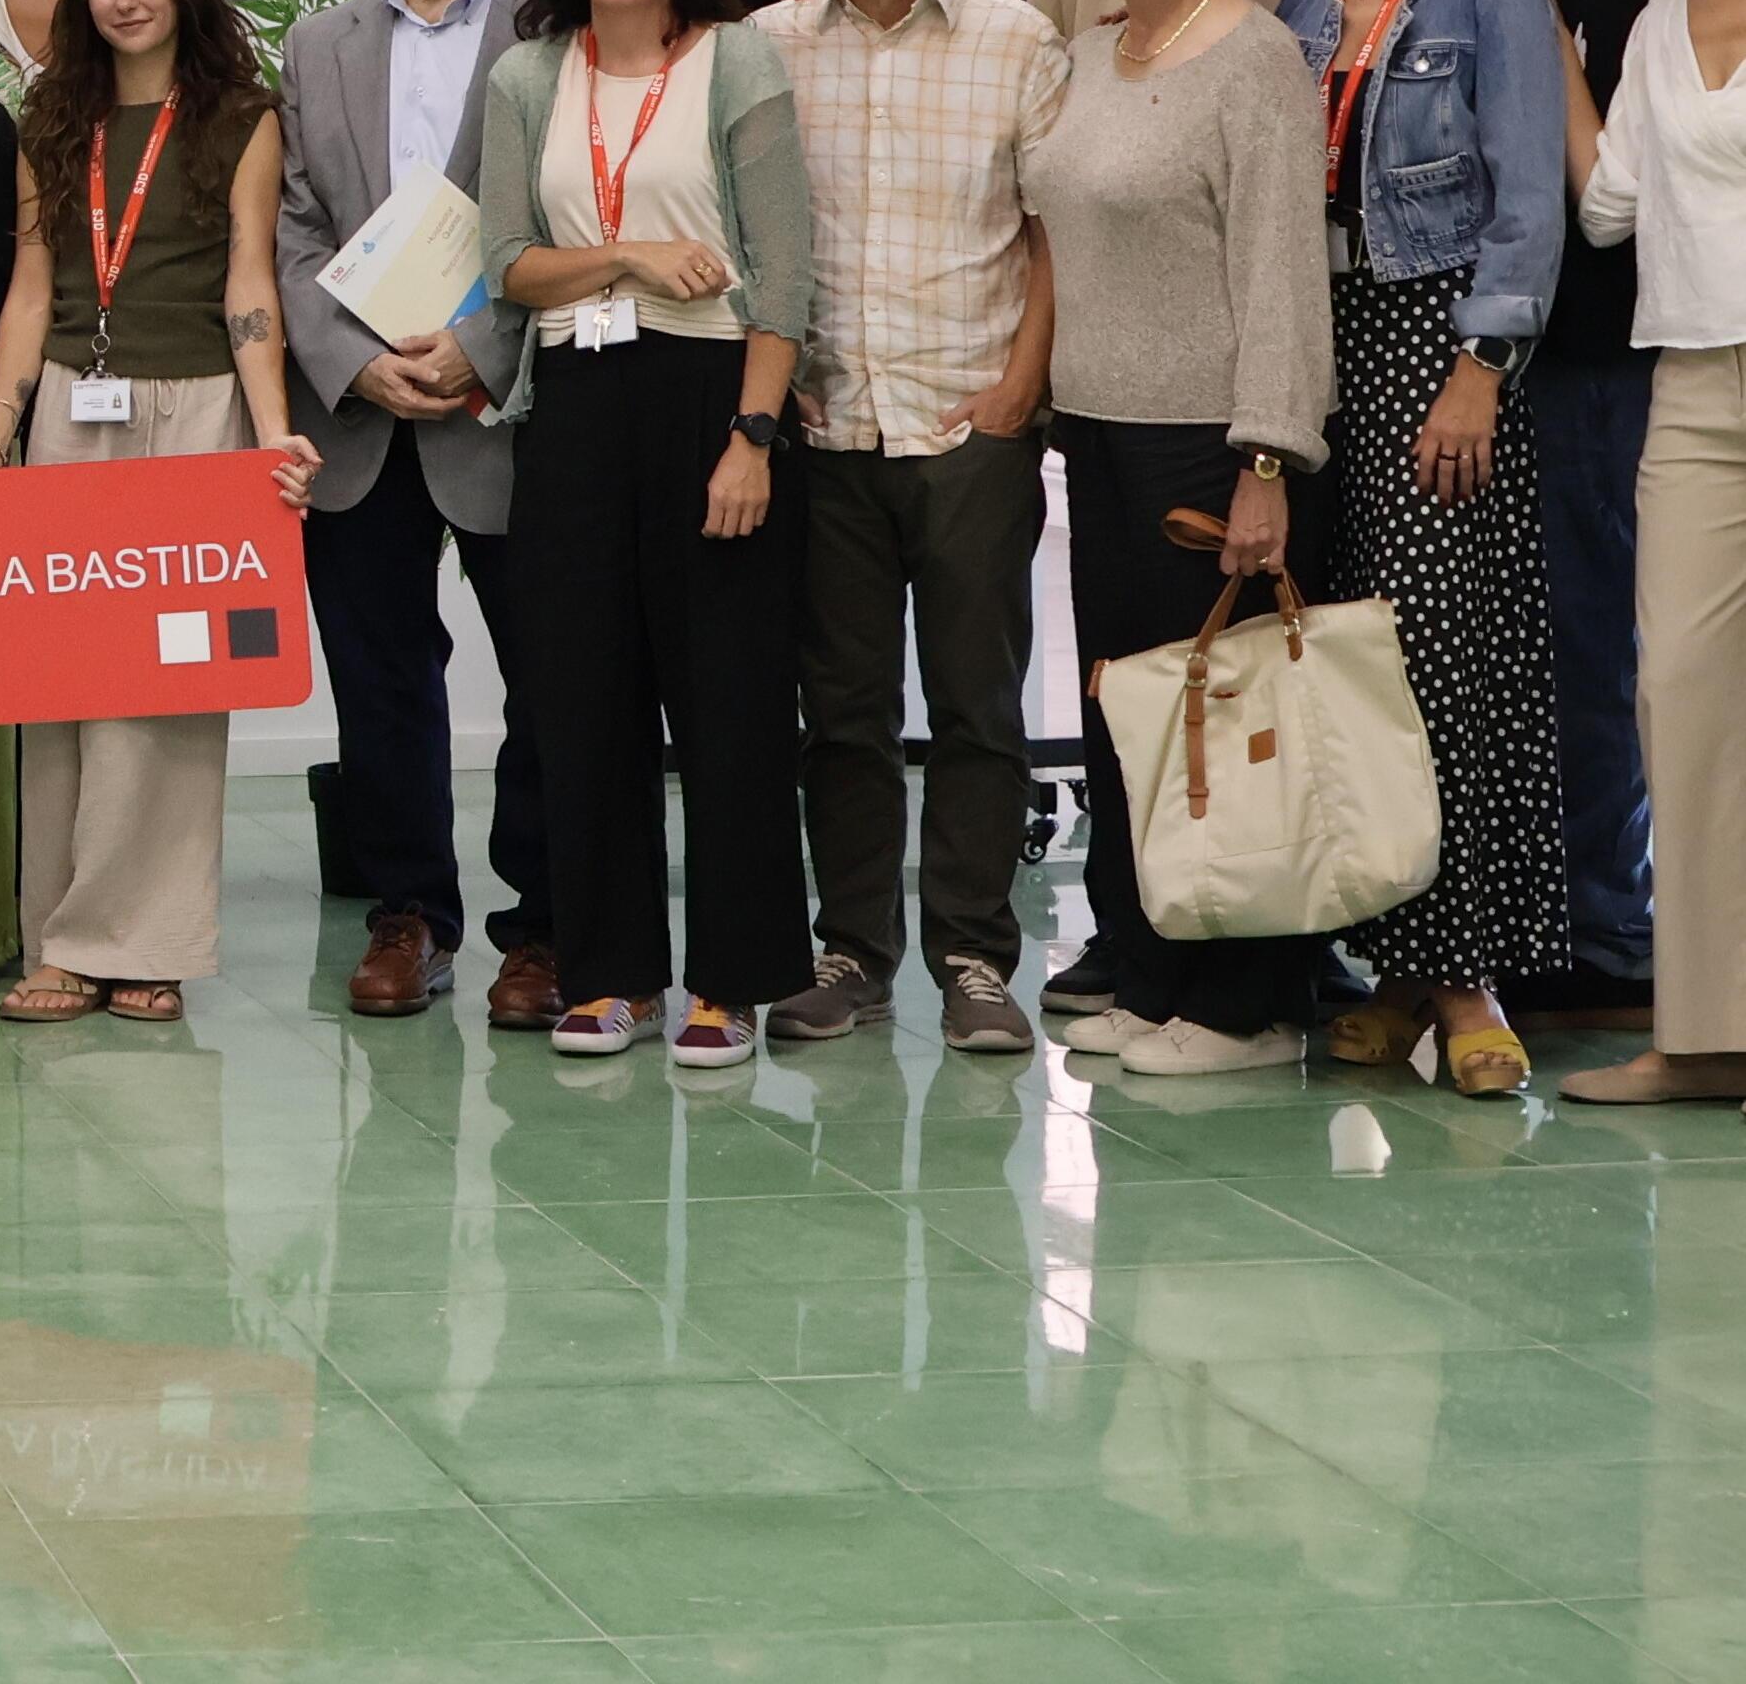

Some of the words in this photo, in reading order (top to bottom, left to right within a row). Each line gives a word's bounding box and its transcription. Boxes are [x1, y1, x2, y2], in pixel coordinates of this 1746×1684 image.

[133, 172, 150, 195] SJD
[92, 208, 105, 231] SJD
[45, 539, 269, 594] BASTIDA
